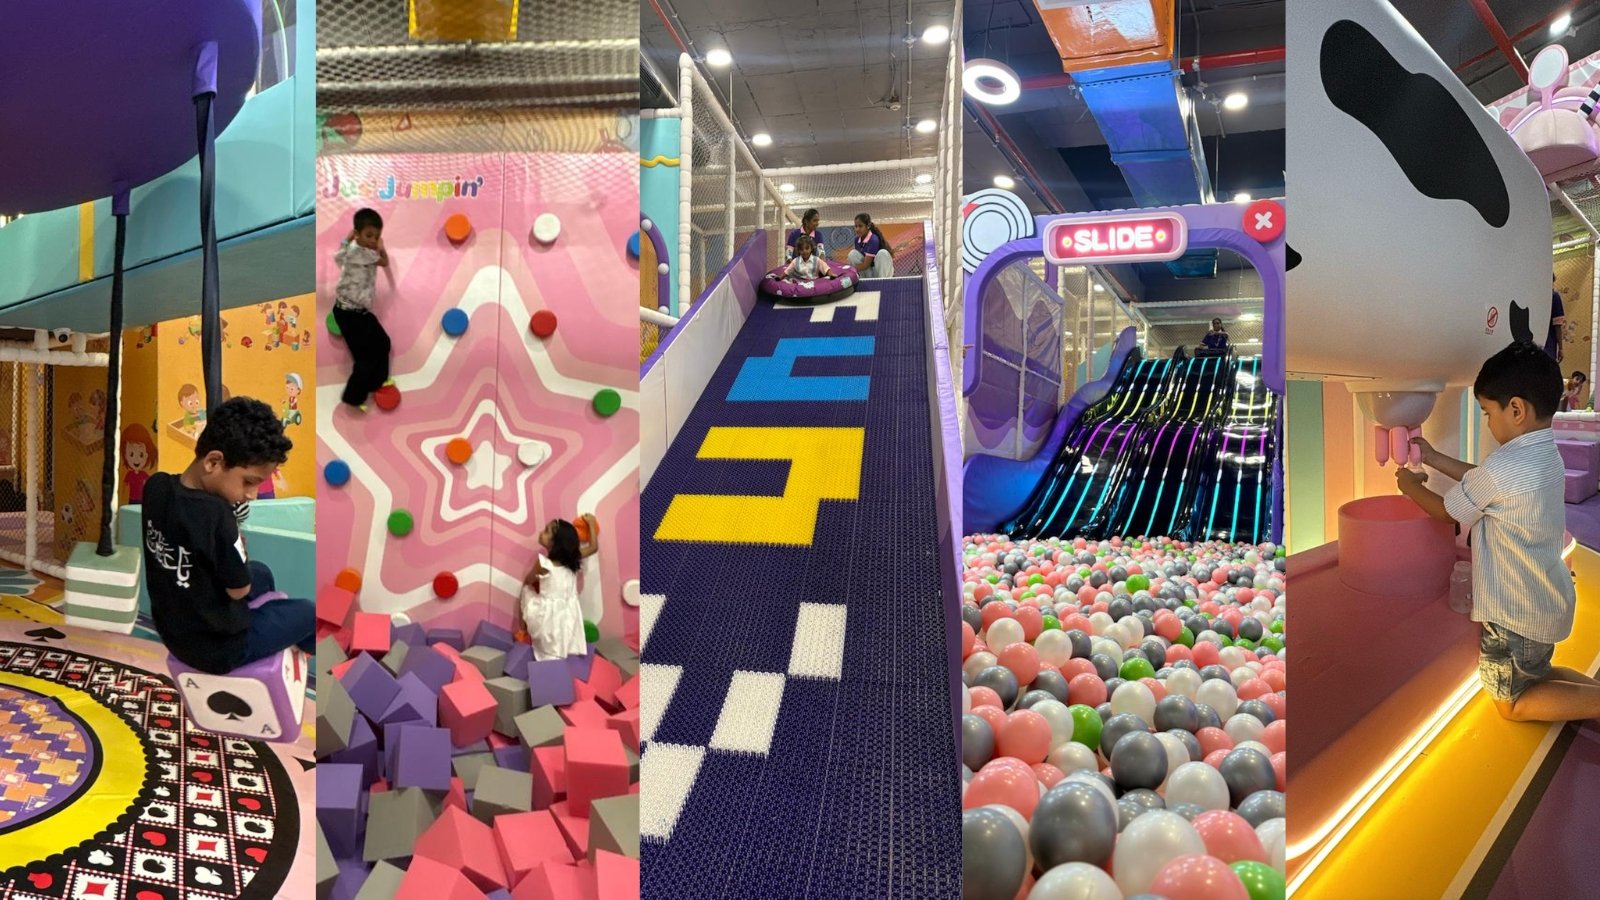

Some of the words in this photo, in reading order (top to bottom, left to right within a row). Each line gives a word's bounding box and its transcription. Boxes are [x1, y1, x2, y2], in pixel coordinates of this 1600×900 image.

[1073, 225, 1154, 252] SLIDE
[185, 677, 200, 689] A
[260, 723, 276, 735] A
